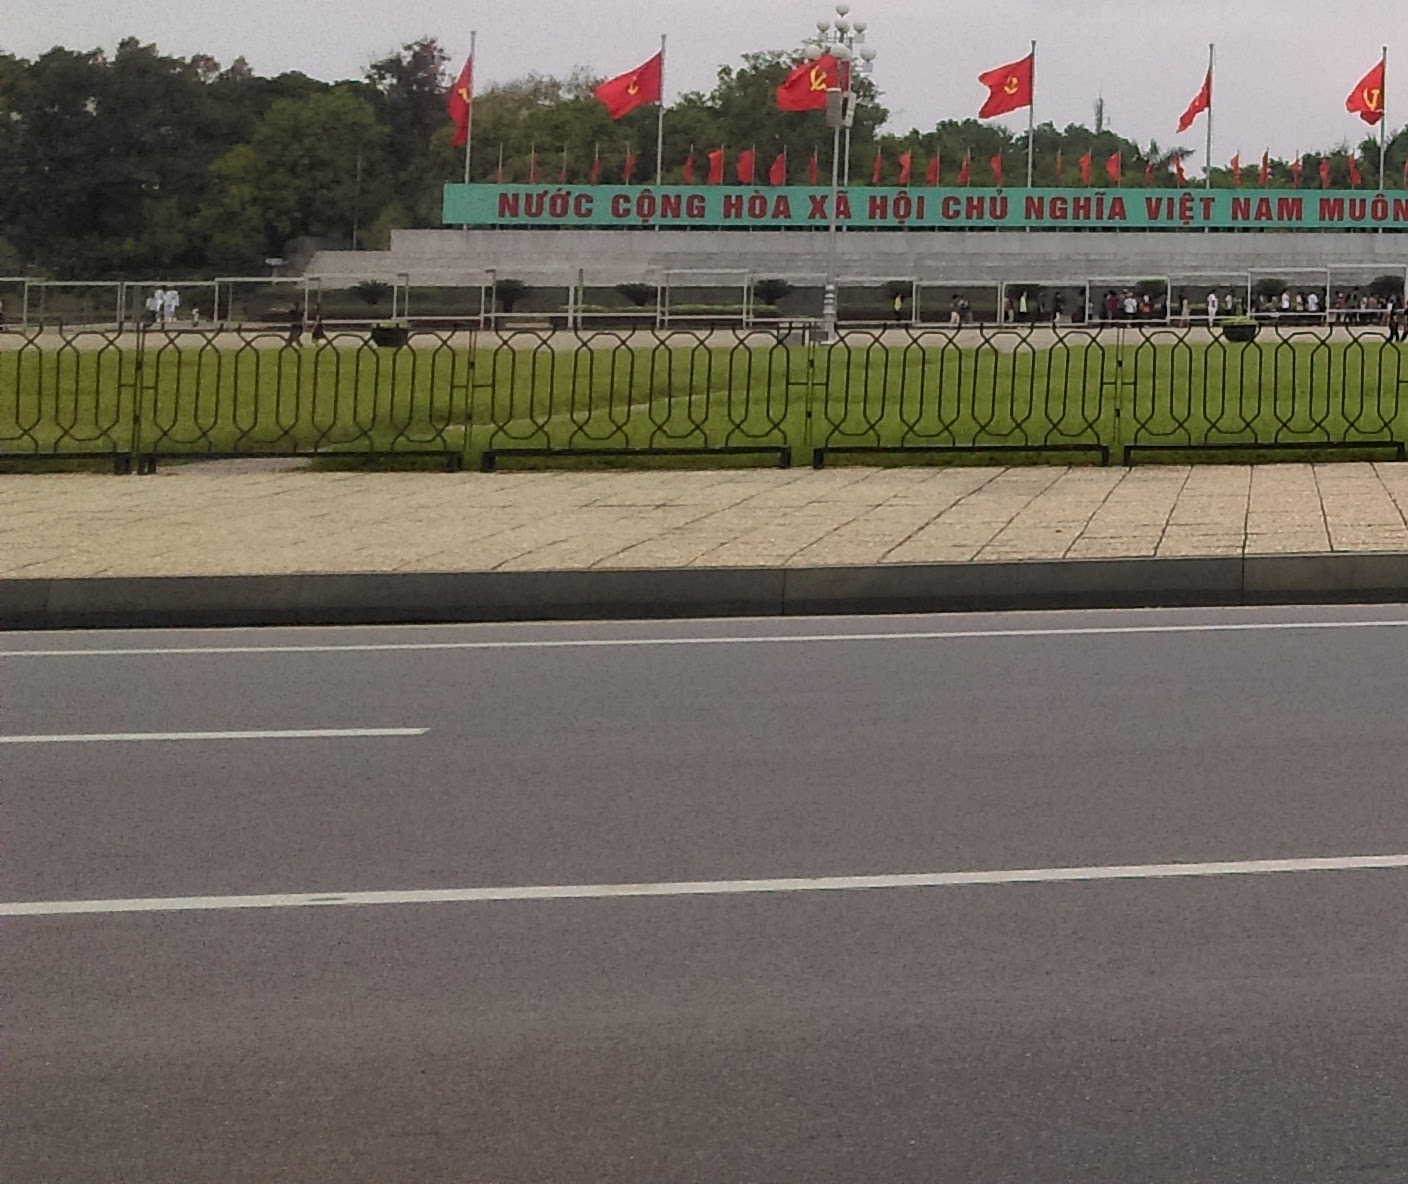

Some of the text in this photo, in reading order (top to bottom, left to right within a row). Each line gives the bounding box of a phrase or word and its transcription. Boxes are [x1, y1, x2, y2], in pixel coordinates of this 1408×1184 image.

[498, 188, 594, 218] NƯỚC
[611, 188, 706, 223] CỘNG
[723, 189, 791, 219] HÒA
[808, 191, 851, 220] XÃ
[869, 191, 924, 224] HỘI
[942, 186, 1008, 219] CHỦ
[1025, 191, 1126, 220] NGHĨA
[1145, 192, 1215, 225] VIỆT
[1231, 197, 1303, 221] NAM
